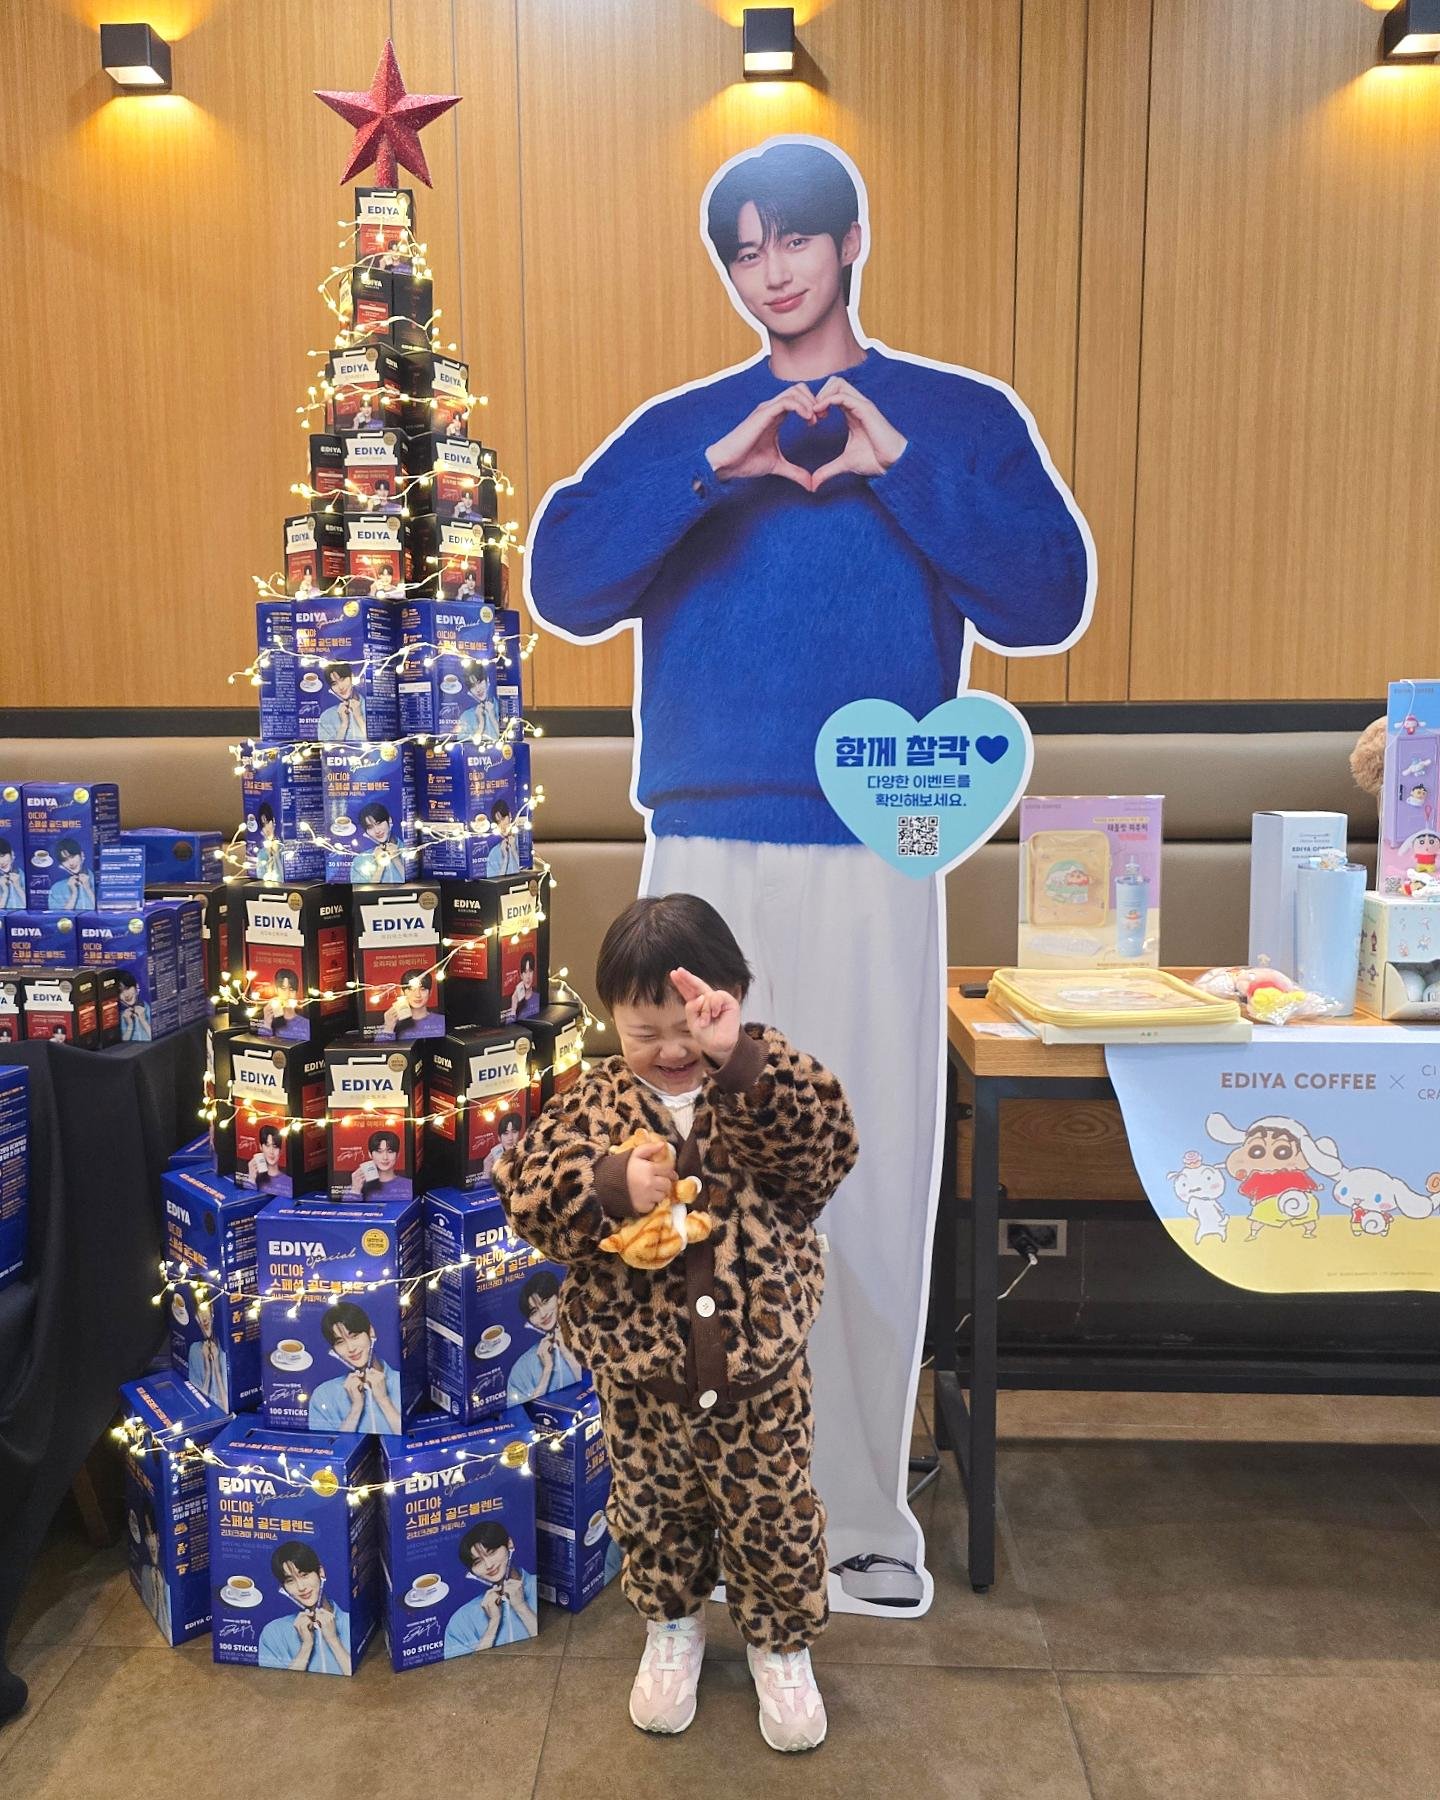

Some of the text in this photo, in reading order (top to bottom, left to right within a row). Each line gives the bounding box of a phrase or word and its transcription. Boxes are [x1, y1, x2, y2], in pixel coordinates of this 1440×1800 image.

[367, 205, 400, 215] EDIYA
[340, 363, 369, 374] EDIYA
[440, 373, 462, 387] EDIYA
[320, 445, 342, 454] EDIYA
[355, 446, 387, 455] EDIYA
[444, 452, 472, 465] EDIYA
[291, 532, 310, 543] EDIYA
[357, 530, 390, 540] EDIYA
[295, 612, 328, 623] EDIYA
[435, 614, 466, 625] EDIYA
[836, 735, 970, 767] 함께 찰칵
[326, 756, 362, 767] EDIYA
[467, 756, 493, 767] EDIYA
[327, 772, 350, 781] 이디야
[867, 774, 971, 789] 다양한 이벤트를
[26, 798, 58, 807] EDIYA
[875, 793, 967, 808] 확인해보세요.
[319, 904, 344, 916] EDIYA
[453, 899, 481, 909] EDIYA
[507, 904, 532, 919] EDIYA
[254, 915, 293, 929] EDIYA
[372, 917, 425, 932] EDIYA
[11, 928, 42, 937] EDIYA
[82, 929, 113, 938] EDIYA
[33, 993, 63, 1002] EDIYA
[433, 1054, 453, 1069] EDIYA
[240, 1070, 277, 1087] EDIYA
[478, 1063, 519, 1082] EDIYA
[341, 1079, 394, 1091] EDIYA
[1220, 1072, 1286, 1089] EDIYA
[1294, 1073, 1377, 1090] COFFEE
[166, 1200, 192, 1226] EDIYA
[475, 1225, 514, 1248] EDIY
[268, 1240, 357, 1270] EDIYA Special
[269, 1263, 305, 1277] 이디야
[269, 1278, 304, 1292] 스페셜
[239, 1388, 259, 1399] EDIYA
[485, 1390, 507, 1404] STICKS
[270, 1407, 308, 1416] 100 STICKS
[405, 1467, 466, 1495] EDIYA
[218, 1477, 305, 1507] EDIYA Special
[220, 1499, 255, 1514] 이디야
[406, 1495, 443, 1515] 이디야
[406, 1497, 504, 1530] 스페셜 골드블렌드
[220, 1514, 315, 1535] 스페셜 골드블렌드
[440, 1520, 467, 1532] 커피믹스
[220, 1529, 278, 1541] 리치크레마 커피믹스
[184, 1618, 205, 1630] EDIYA
[233, 1645, 258, 1653] STICKS
[402, 1640, 444, 1657] 100 STICKS
